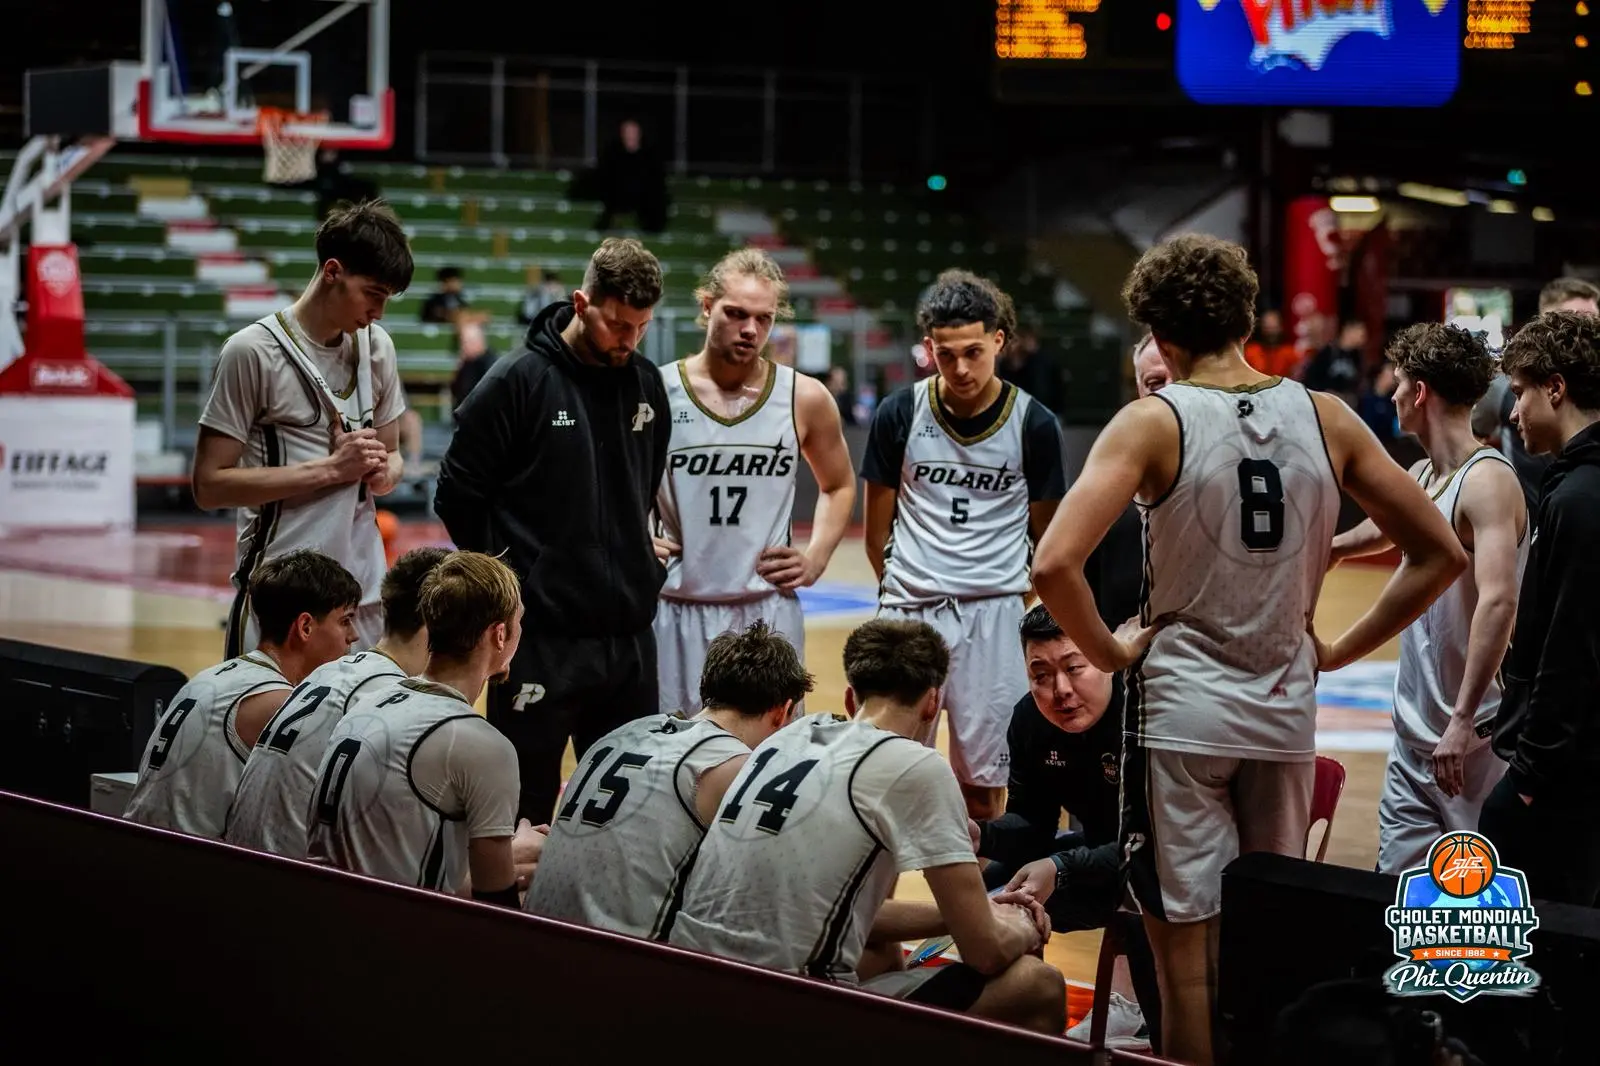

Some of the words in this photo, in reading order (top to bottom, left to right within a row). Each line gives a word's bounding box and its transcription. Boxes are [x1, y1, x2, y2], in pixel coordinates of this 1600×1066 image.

[11, 453, 107, 472] EIFFAGE
[670, 453, 794, 477] POLARIS
[913, 464, 1016, 492] POLARIS
[709, 486, 748, 525] 17
[950, 497, 970, 524] 5
[1237, 458, 1284, 553] 8
[148, 698, 197, 771] 9
[255, 680, 332, 756] 12
[317, 737, 362, 826] 0
[557, 745, 654, 828] 15
[718, 746, 820, 836] 14
